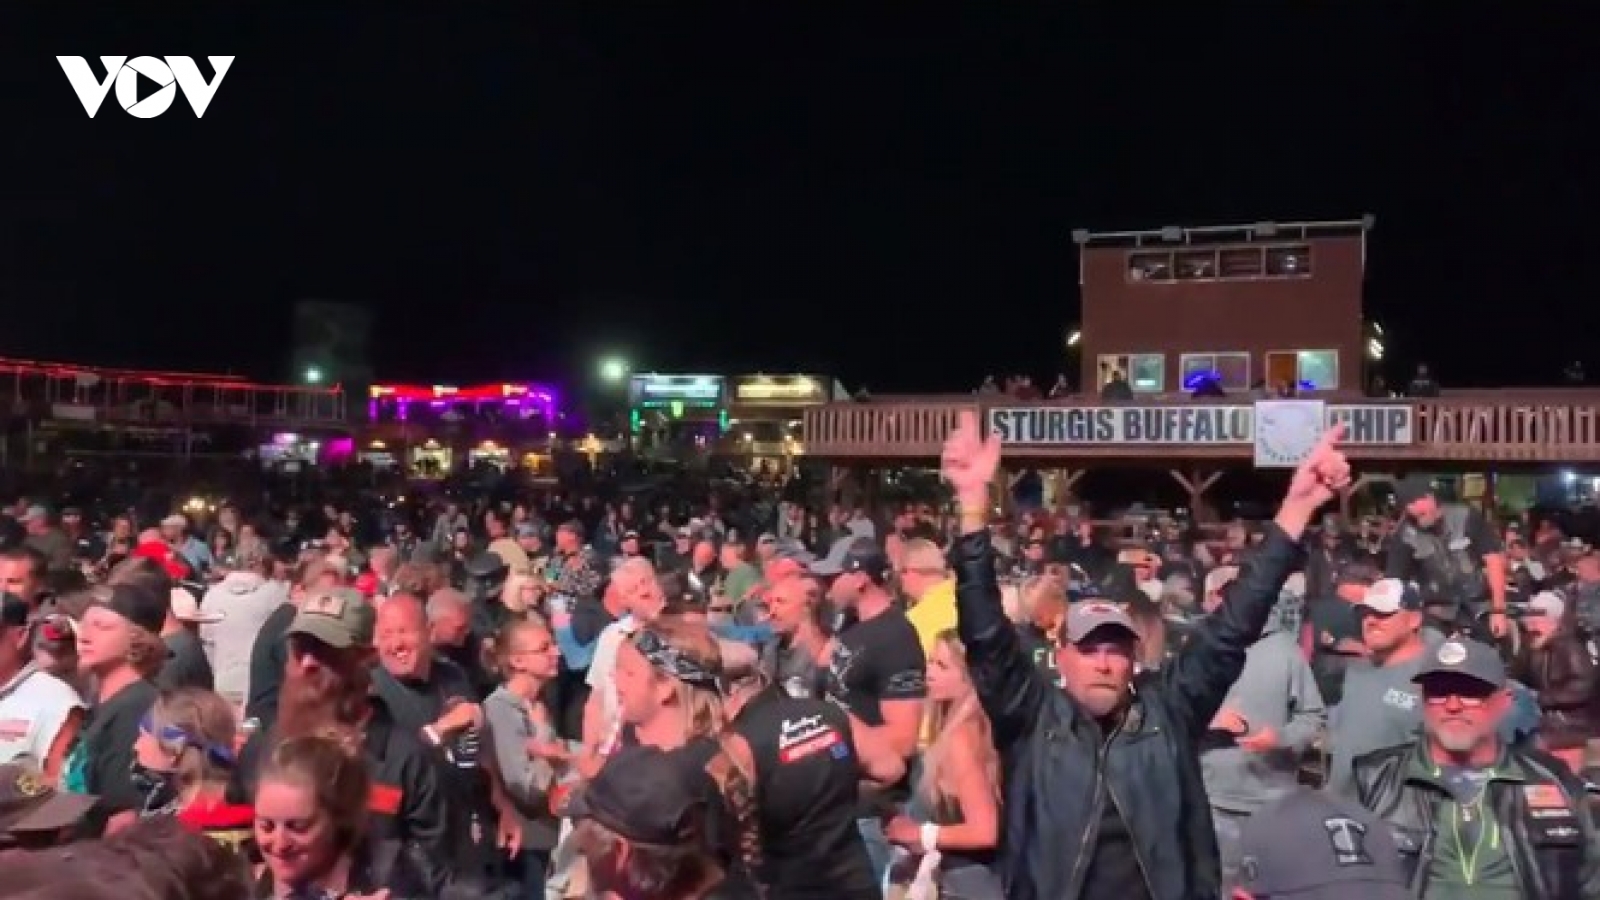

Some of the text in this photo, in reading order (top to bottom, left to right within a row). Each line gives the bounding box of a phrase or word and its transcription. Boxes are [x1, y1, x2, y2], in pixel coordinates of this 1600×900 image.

[992, 408, 1115, 441] STURGIS
[1123, 408, 1251, 441] BUFFALO
[1330, 408, 1407, 441] CHIP
